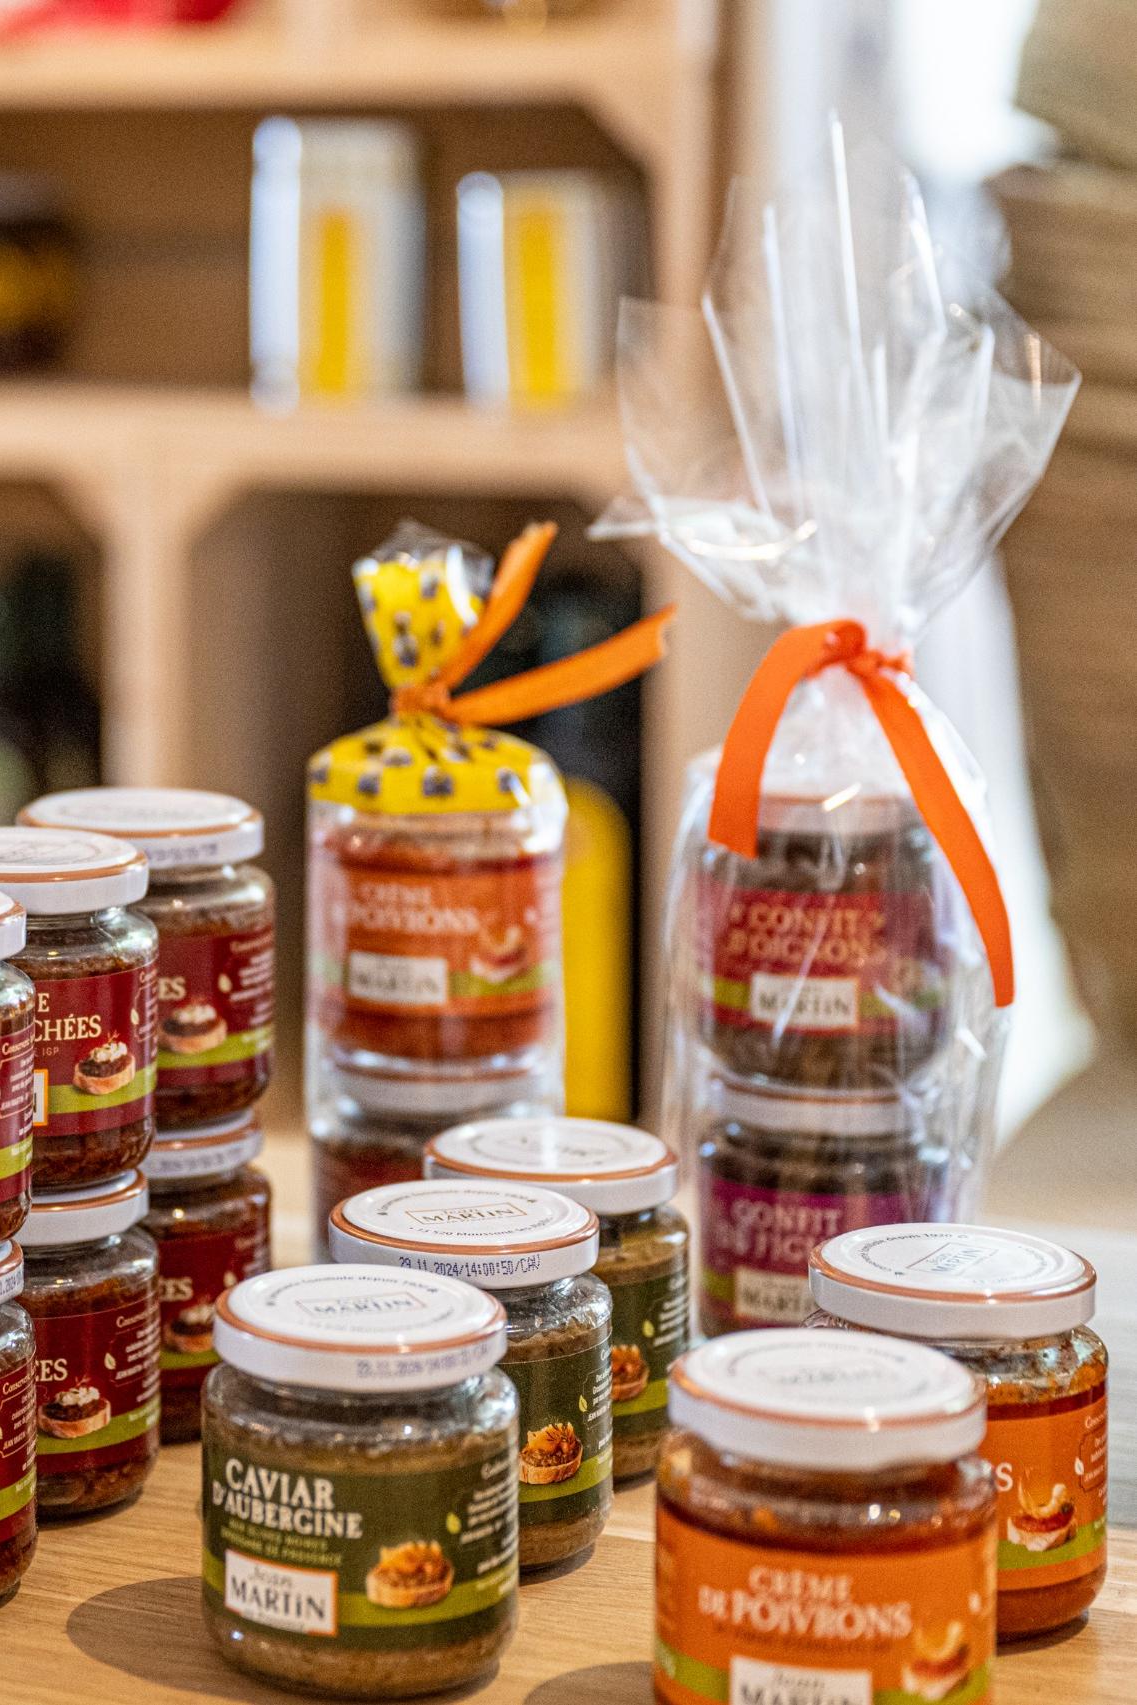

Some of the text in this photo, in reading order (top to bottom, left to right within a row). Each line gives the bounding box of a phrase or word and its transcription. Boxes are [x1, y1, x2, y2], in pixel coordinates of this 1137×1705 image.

[33, 1014, 102, 1042] CHÉES
[212, 1478, 364, 1540] D'AUBERGINE
[224, 1457, 336, 1511] CAVIAR
[730, 1589, 913, 1640] POIVRONS
